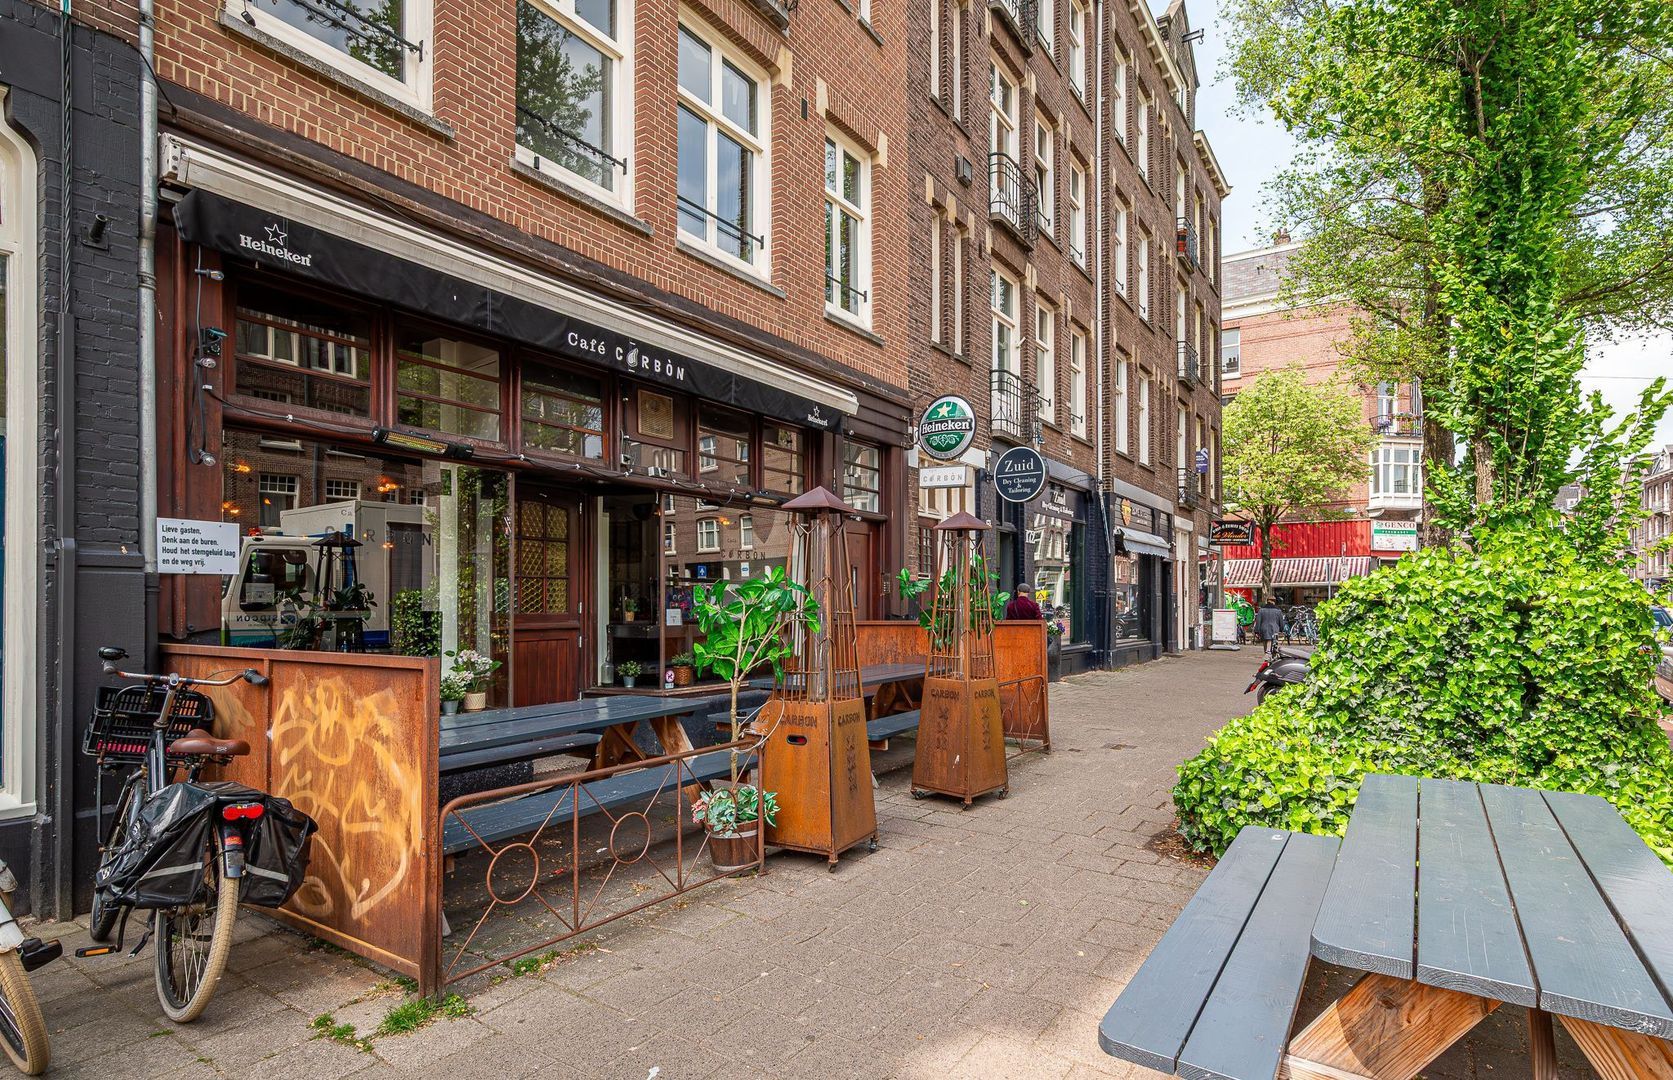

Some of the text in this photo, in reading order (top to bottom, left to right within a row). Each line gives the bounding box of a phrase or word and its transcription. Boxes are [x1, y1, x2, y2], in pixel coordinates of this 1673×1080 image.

[240, 234, 312, 267] Heineken
[568, 332, 606, 354] Café
[808, 414, 828, 426] Heineken
[922, 419, 970, 434] Heineken
[1005, 458, 1034, 472] Zuid
[162, 525, 178, 533] Lieve
[192, 537, 199, 545] de
[192, 548, 222, 557] stemgeluid
[224, 549, 235, 558] laag
[194, 559, 205, 567] vrij.
[931, 688, 960, 700] CARBON
[975, 688, 996, 699] CARBON
[838, 712, 860, 727] CARBON
